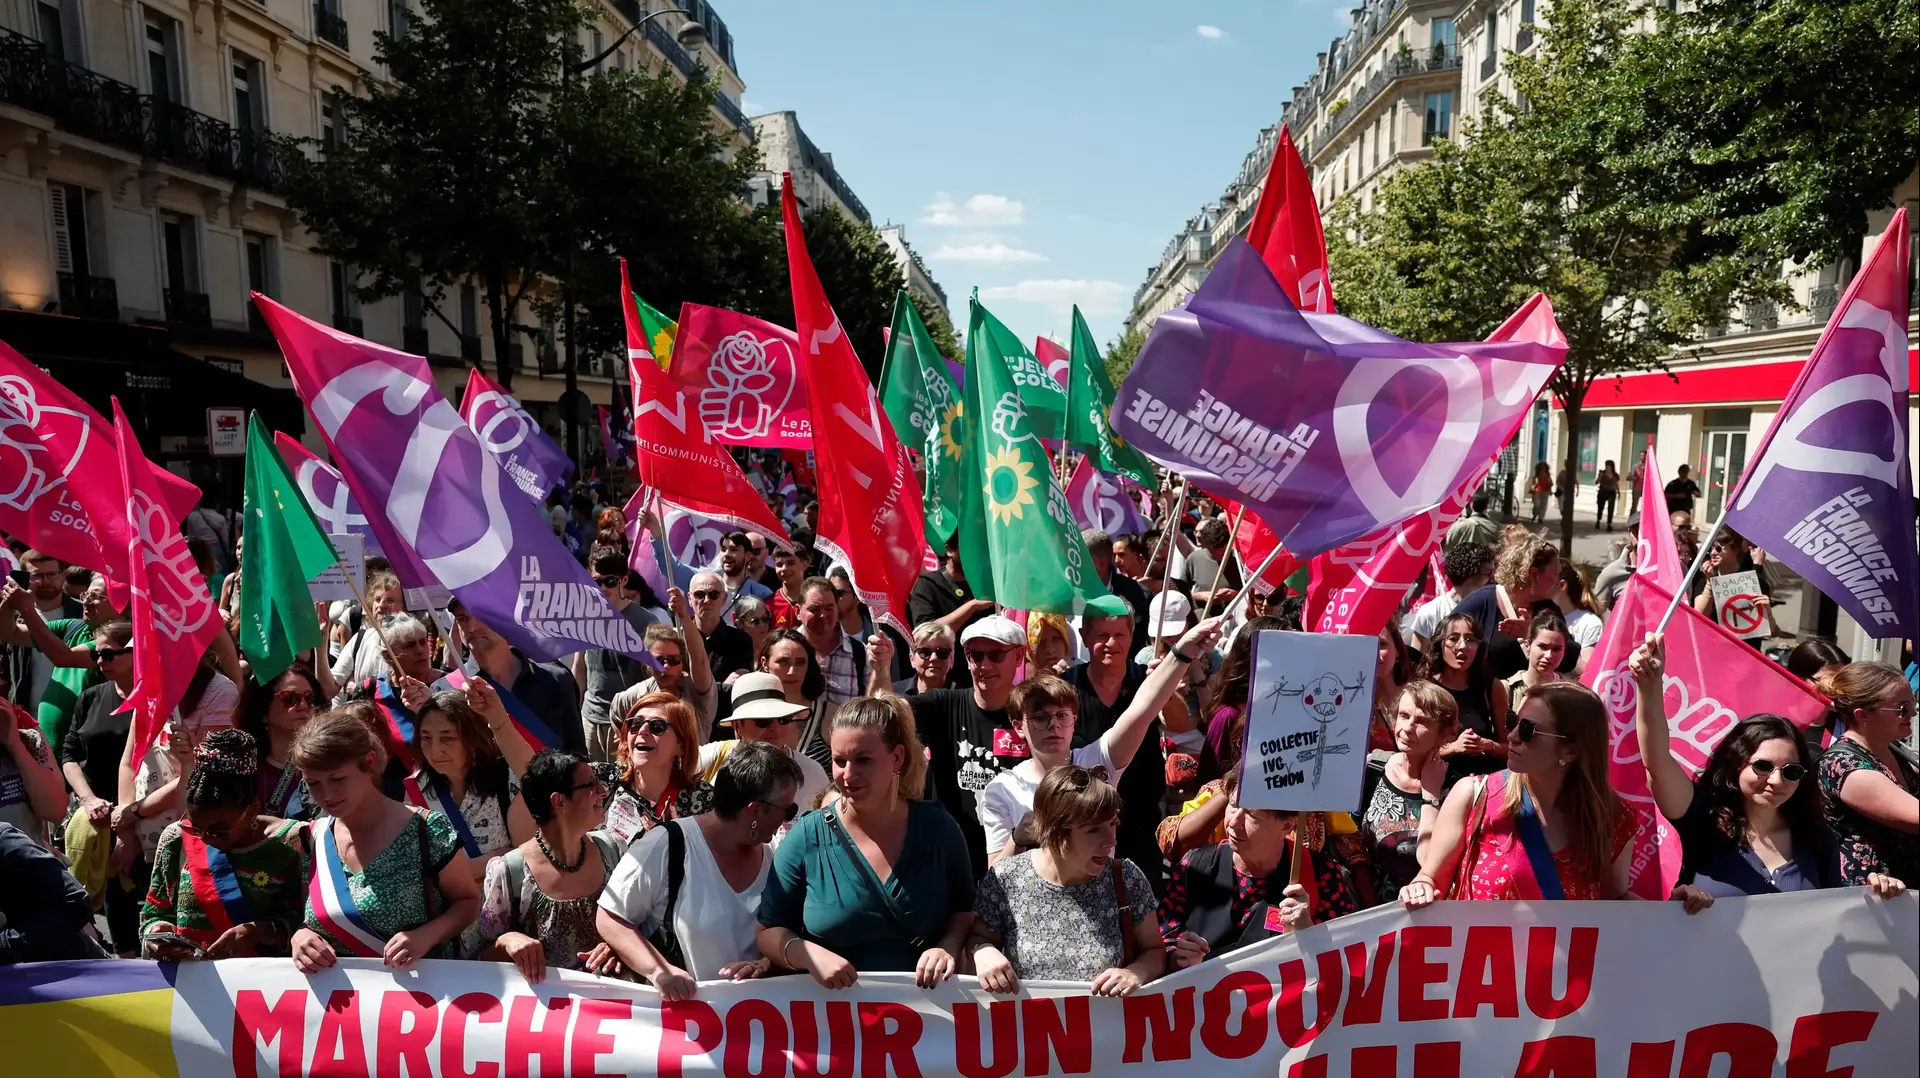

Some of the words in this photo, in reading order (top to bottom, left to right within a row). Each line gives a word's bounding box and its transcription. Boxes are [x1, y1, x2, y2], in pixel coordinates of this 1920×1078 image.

[782, 416, 798, 428] Le
[652, 443, 732, 473] COMMUNISTE
[504, 460, 538, 485] FRANCE
[58, 490, 82, 512] Le
[1842, 486, 1874, 508] LA
[1804, 495, 1900, 584] FRANCE
[520, 556, 540, 581] LA
[514, 582, 614, 626] FRANCE
[1338, 588, 1356, 617] Le
[252, 613, 269, 652] PARIS
[1260, 730, 1320, 756] COLLECTIF
[1264, 770, 1304, 790] TENON
[1122, 925, 1599, 1064] NOUVEAU
[232, 989, 633, 1078] MARCHE
[658, 998, 924, 1078] POUR
[953, 995, 1092, 1078] UN
